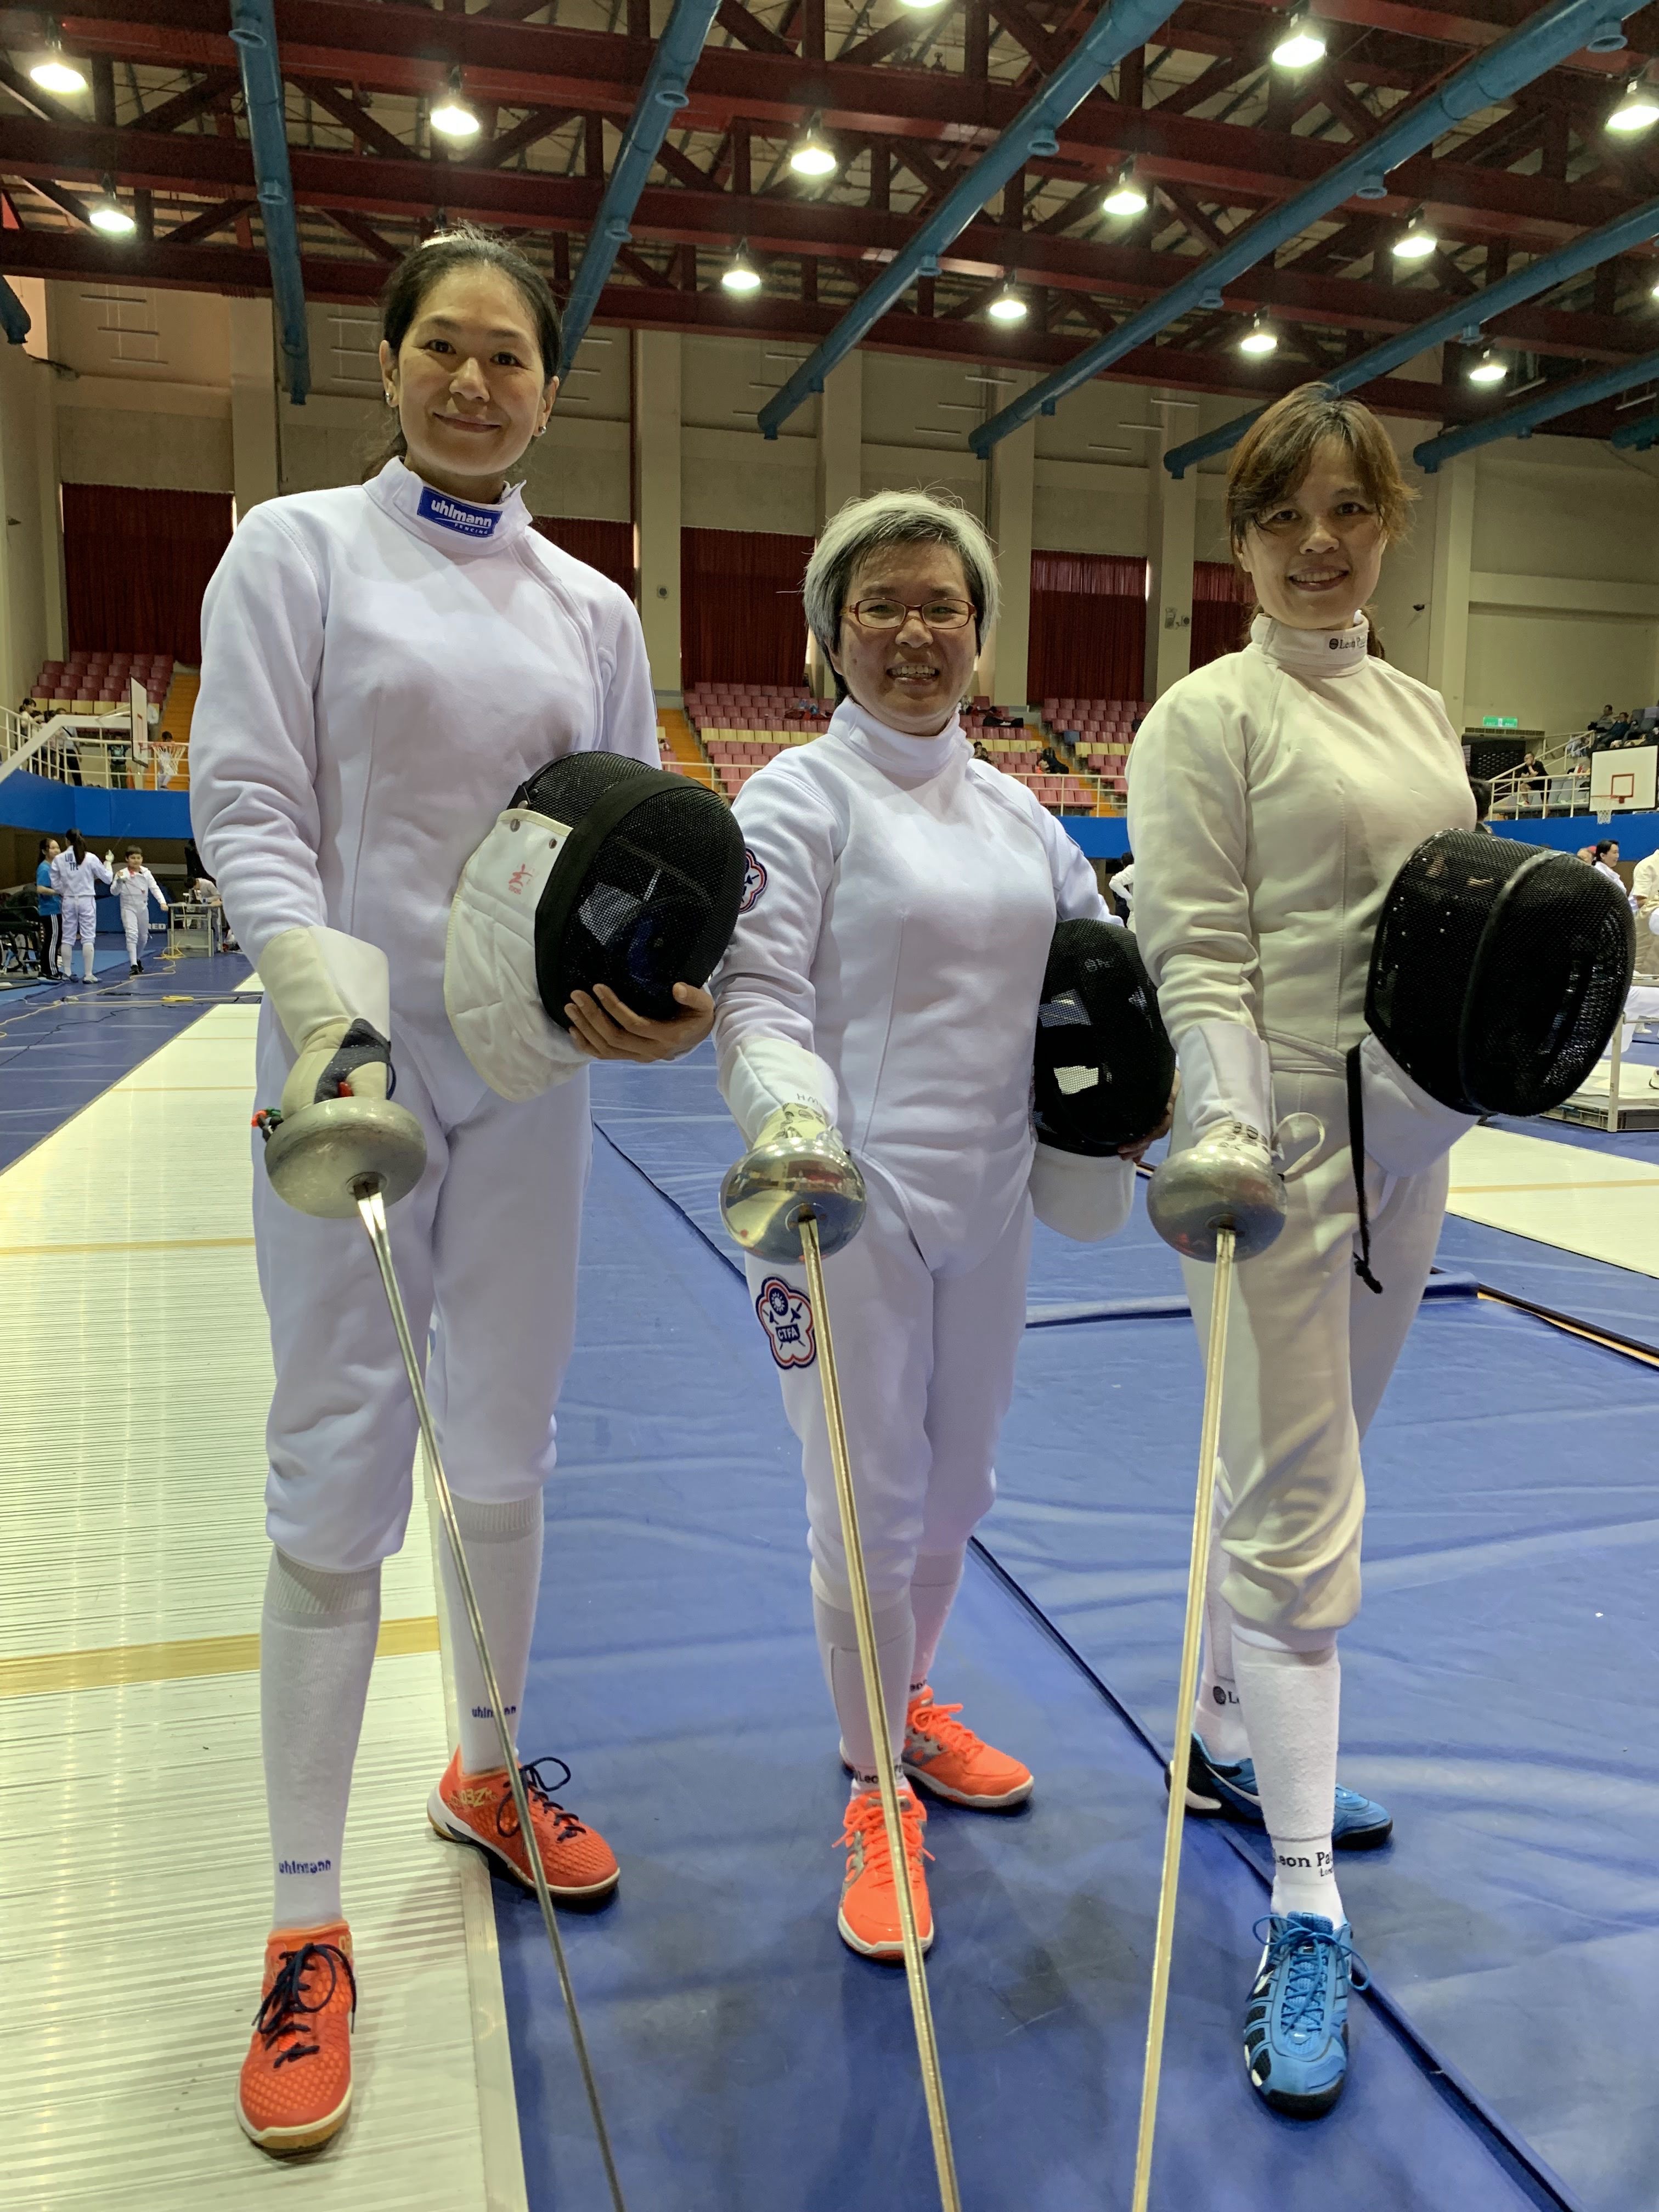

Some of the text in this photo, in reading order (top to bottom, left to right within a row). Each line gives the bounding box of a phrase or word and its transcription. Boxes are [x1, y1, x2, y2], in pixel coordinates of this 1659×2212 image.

[431, 499, 492, 527] uhlmann
[454, 523, 488, 534] FENCING
[777, 1326, 798, 1340] CTFA
[472, 1706, 516, 1718] uhlmnn
[279, 1860, 331, 1874] uhlmann
